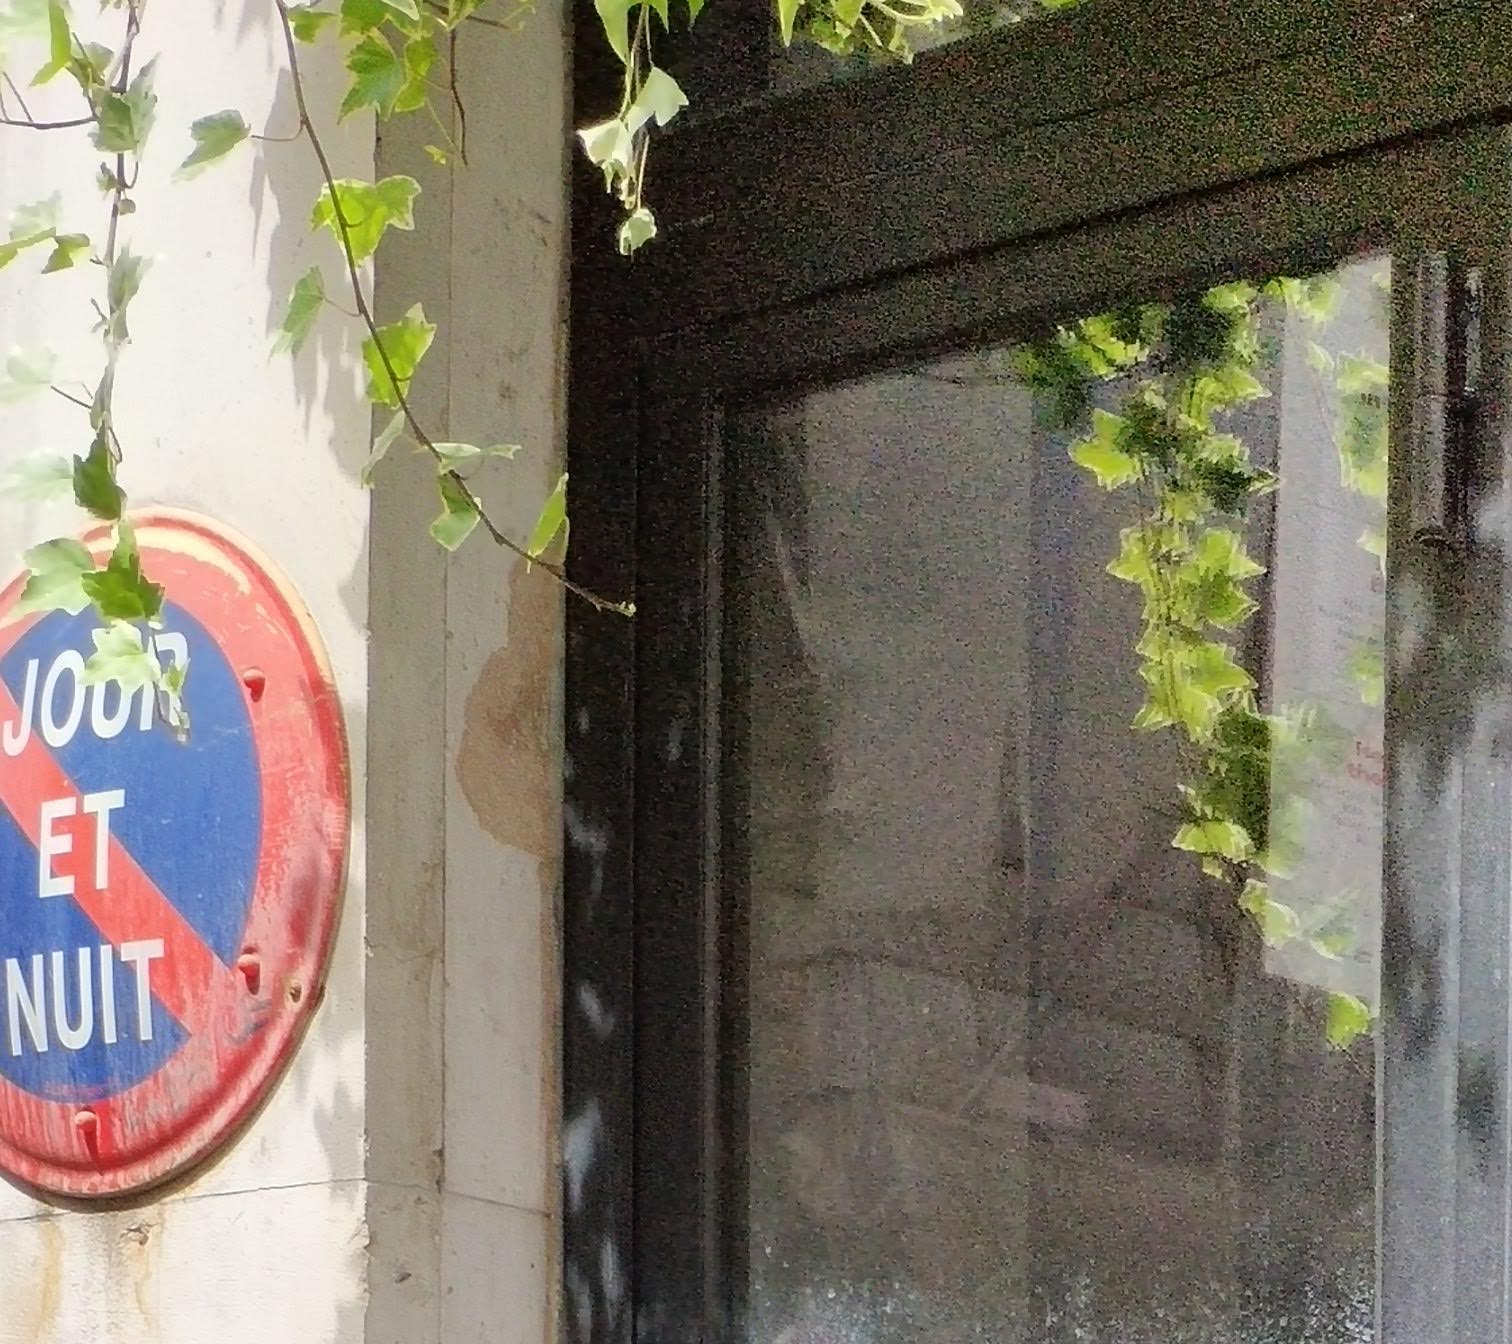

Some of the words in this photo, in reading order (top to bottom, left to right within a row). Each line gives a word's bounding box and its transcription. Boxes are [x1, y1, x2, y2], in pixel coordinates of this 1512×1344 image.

[3, 631, 190, 757] JOUR
[39, 789, 126, 898] ET
[6, 938, 165, 1056] NUIT
